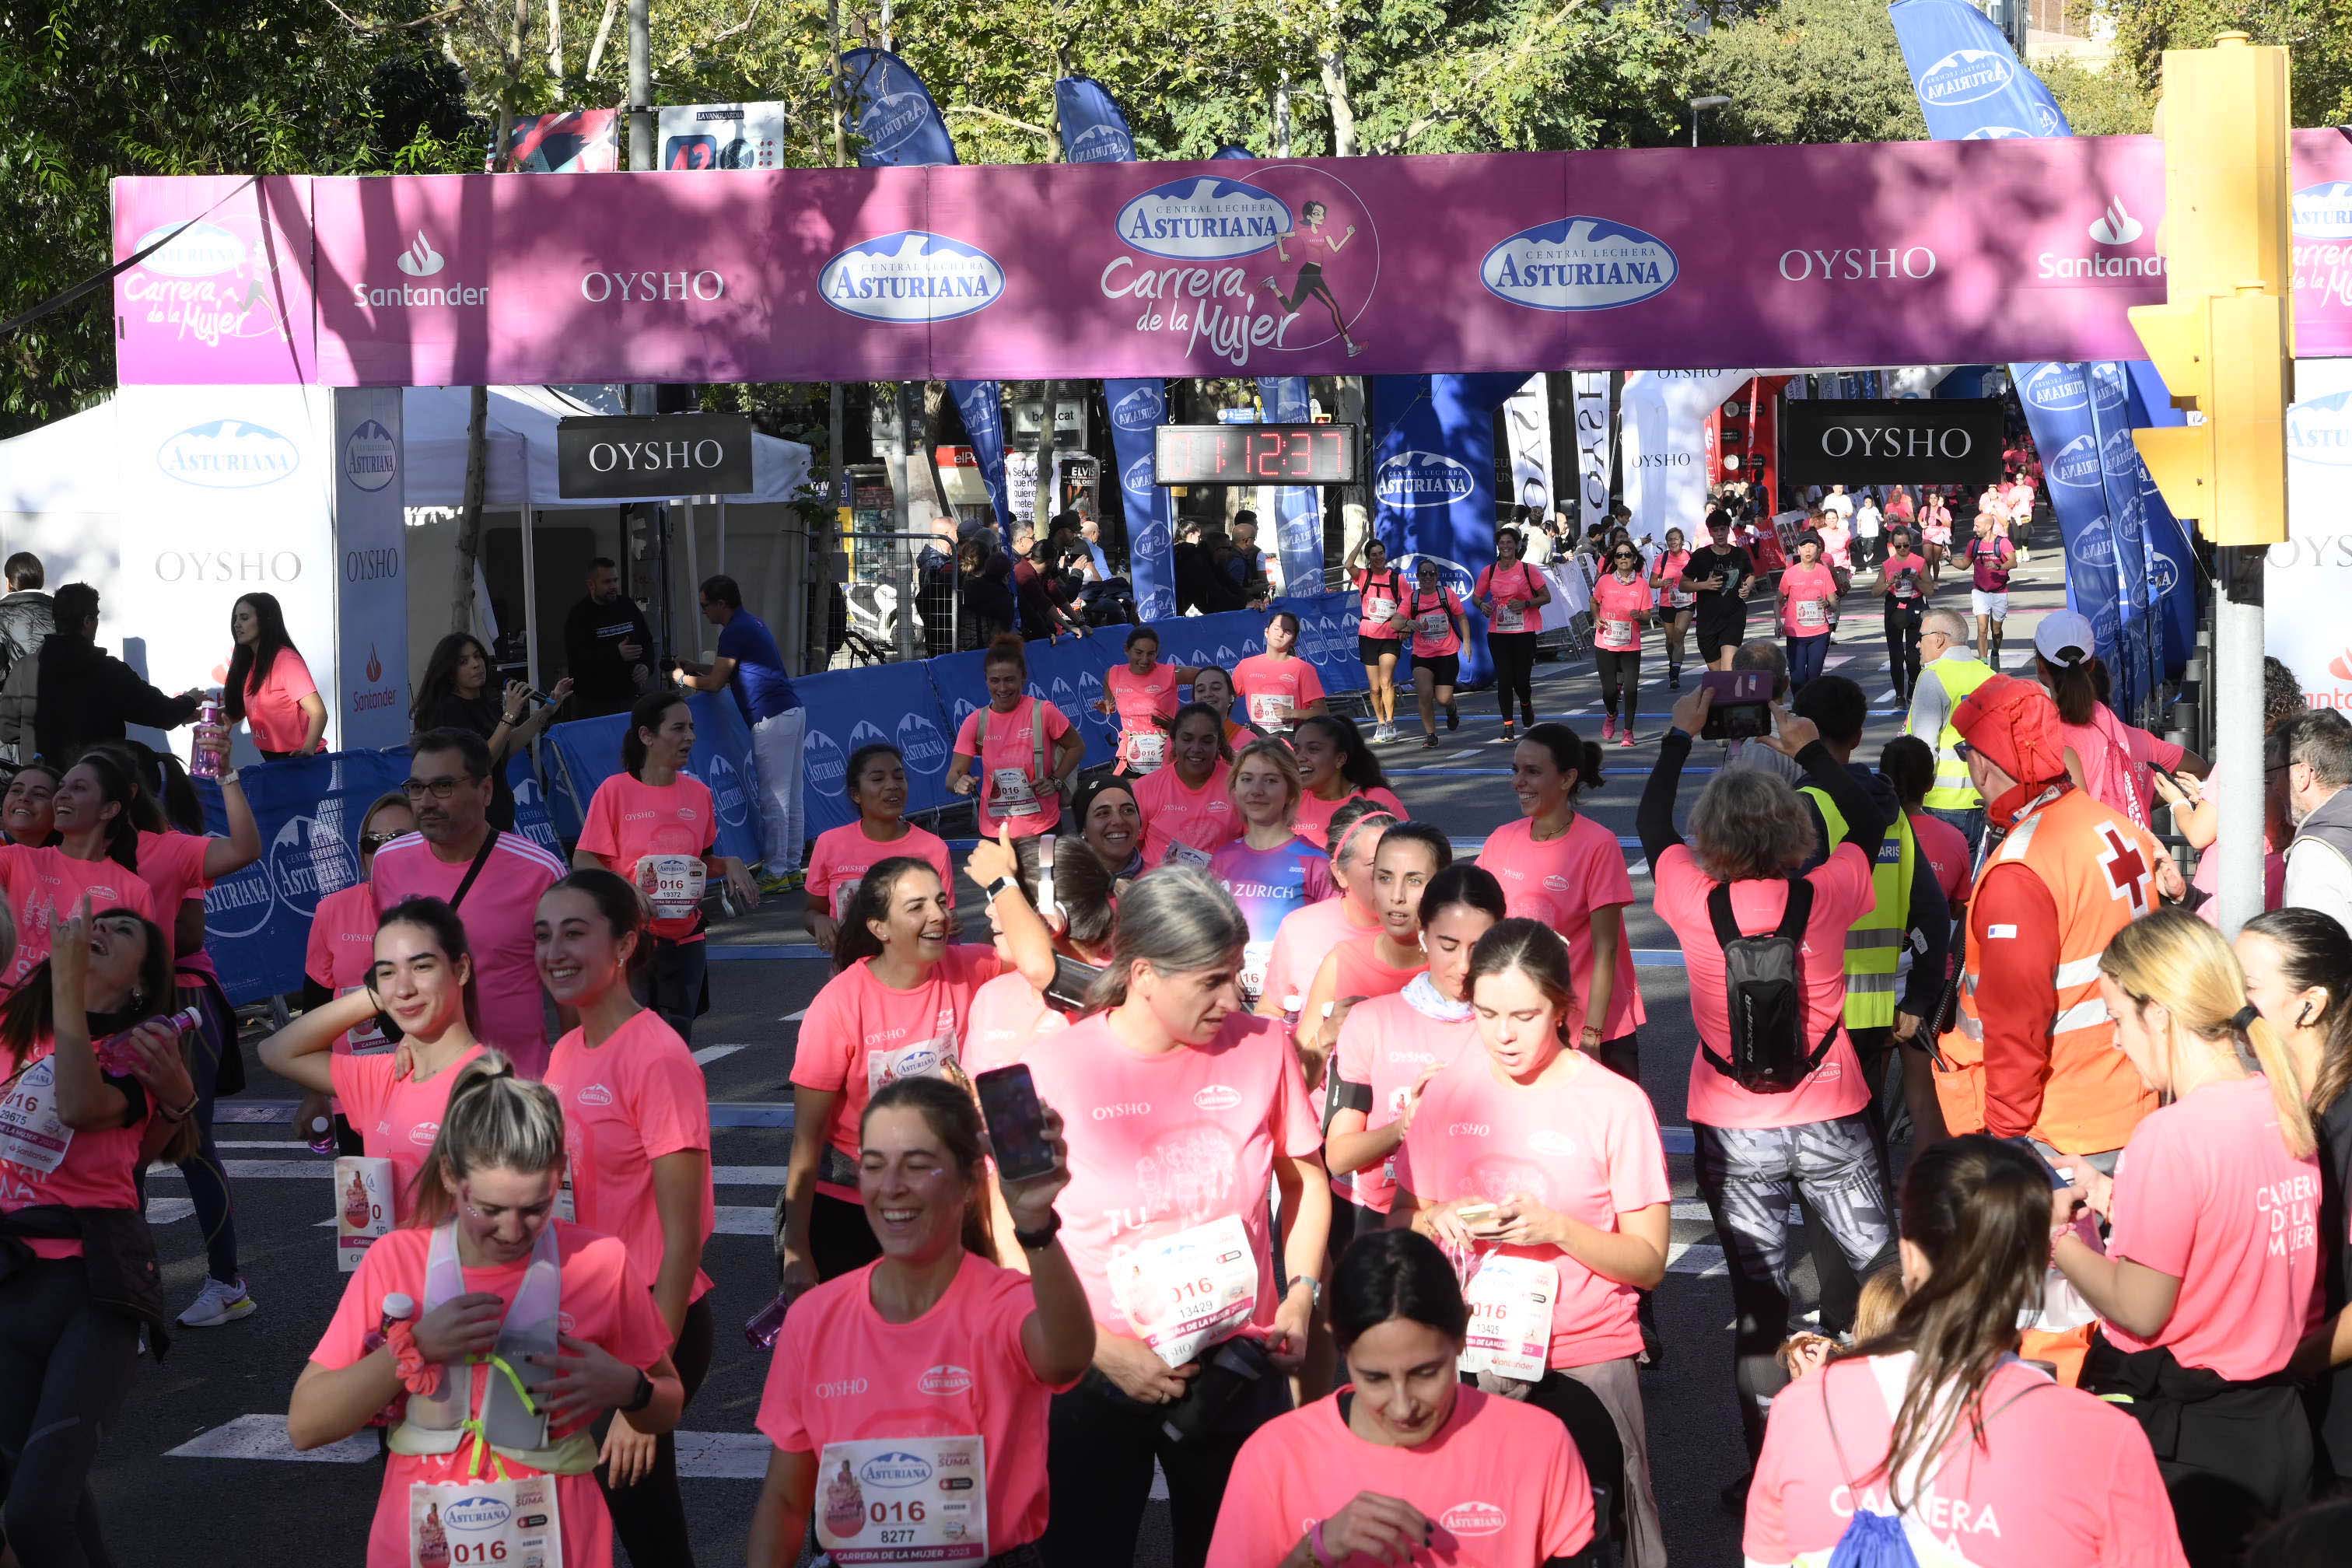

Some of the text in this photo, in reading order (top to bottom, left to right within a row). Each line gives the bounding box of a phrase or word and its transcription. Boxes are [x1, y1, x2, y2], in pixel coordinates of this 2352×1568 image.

[704, 111, 744, 120] VANGUARDIA
[1156, 203, 1275, 214] CENTRAL LECHERA
[1129, 208, 1278, 240] ASTURIANA
[1526, 248, 1656, 259] CENTRAL LECHERA
[861, 261, 984, 273] CENTRAL LECHERA
[1496, 254, 1662, 288] ASTURIANA
[1779, 247, 1937, 281] OYSHO
[124, 272, 217, 302] Carrera
[581, 270, 723, 303] OYSHO
[832, 265, 991, 300] ASTURIANA
[1101, 255, 1246, 299] Carrera
[354, 282, 489, 308] Santander
[147, 299, 251, 348] de la Mujer
[1136, 292, 1300, 366] de la Mujer
[1822, 427, 1972, 460] OYSHO
[169, 446, 289, 473] ASTURIANA
[348, 448, 394, 475] ASTURIANA
[589, 440, 723, 473] OYSHO
[1632, 453, 1691, 468] OYSHO
[1014, 480, 1027, 488] que
[1378, 474, 1467, 496] ASTURIANA
[156, 551, 302, 583] OYSHO
[346, 548, 398, 583] OYSHO
[353, 687, 397, 713] Santander
[904, 737, 945, 761] ASTURIANA
[810, 759, 845, 782] ASTURIANA
[716, 790, 746, 810] ASTURIANA
[625, 810, 655, 821] OYSHO
[660, 880, 684, 890] 016
[1234, 884, 1294, 899] ZURICH
[1244, 973, 1259, 983] 16
[865, 1027, 906, 1046] OYSHO
[900, 1056, 936, 1073] ASTURIANA
[1092, 1101, 1151, 1121] OYSHO
[16, 1129, 39, 1142] MUJER
[16, 1145, 54, 1164] Santander
[2292, 1202, 2312, 1226] LA
[1179, 1300, 1213, 1318] 13429
[1473, 1301, 1507, 1320] 016
[1186, 1322, 1199, 1333] DE
[1199, 1320, 1209, 1330] LA
[1476, 1324, 1500, 1335] 13425
[816, 1377, 869, 1398] OYSHO
[866, 1466, 927, 1479] ASTURIANA
[938, 1458, 971, 1468] SUMA
[516, 1497, 544, 1507] SUMA
[870, 1500, 926, 1523] 016
[447, 1509, 506, 1524] ASTURIANA
[1446, 1516, 1503, 1528] ASTURIANA
[881, 1530, 915, 1544] 8277
[454, 1540, 508, 1563] 016
[835, 1552, 880, 1562] CARRERA
[880, 1550, 894, 1559] DE
[895, 1550, 909, 1559] LA
[910, 1549, 944, 1559] MUJER
